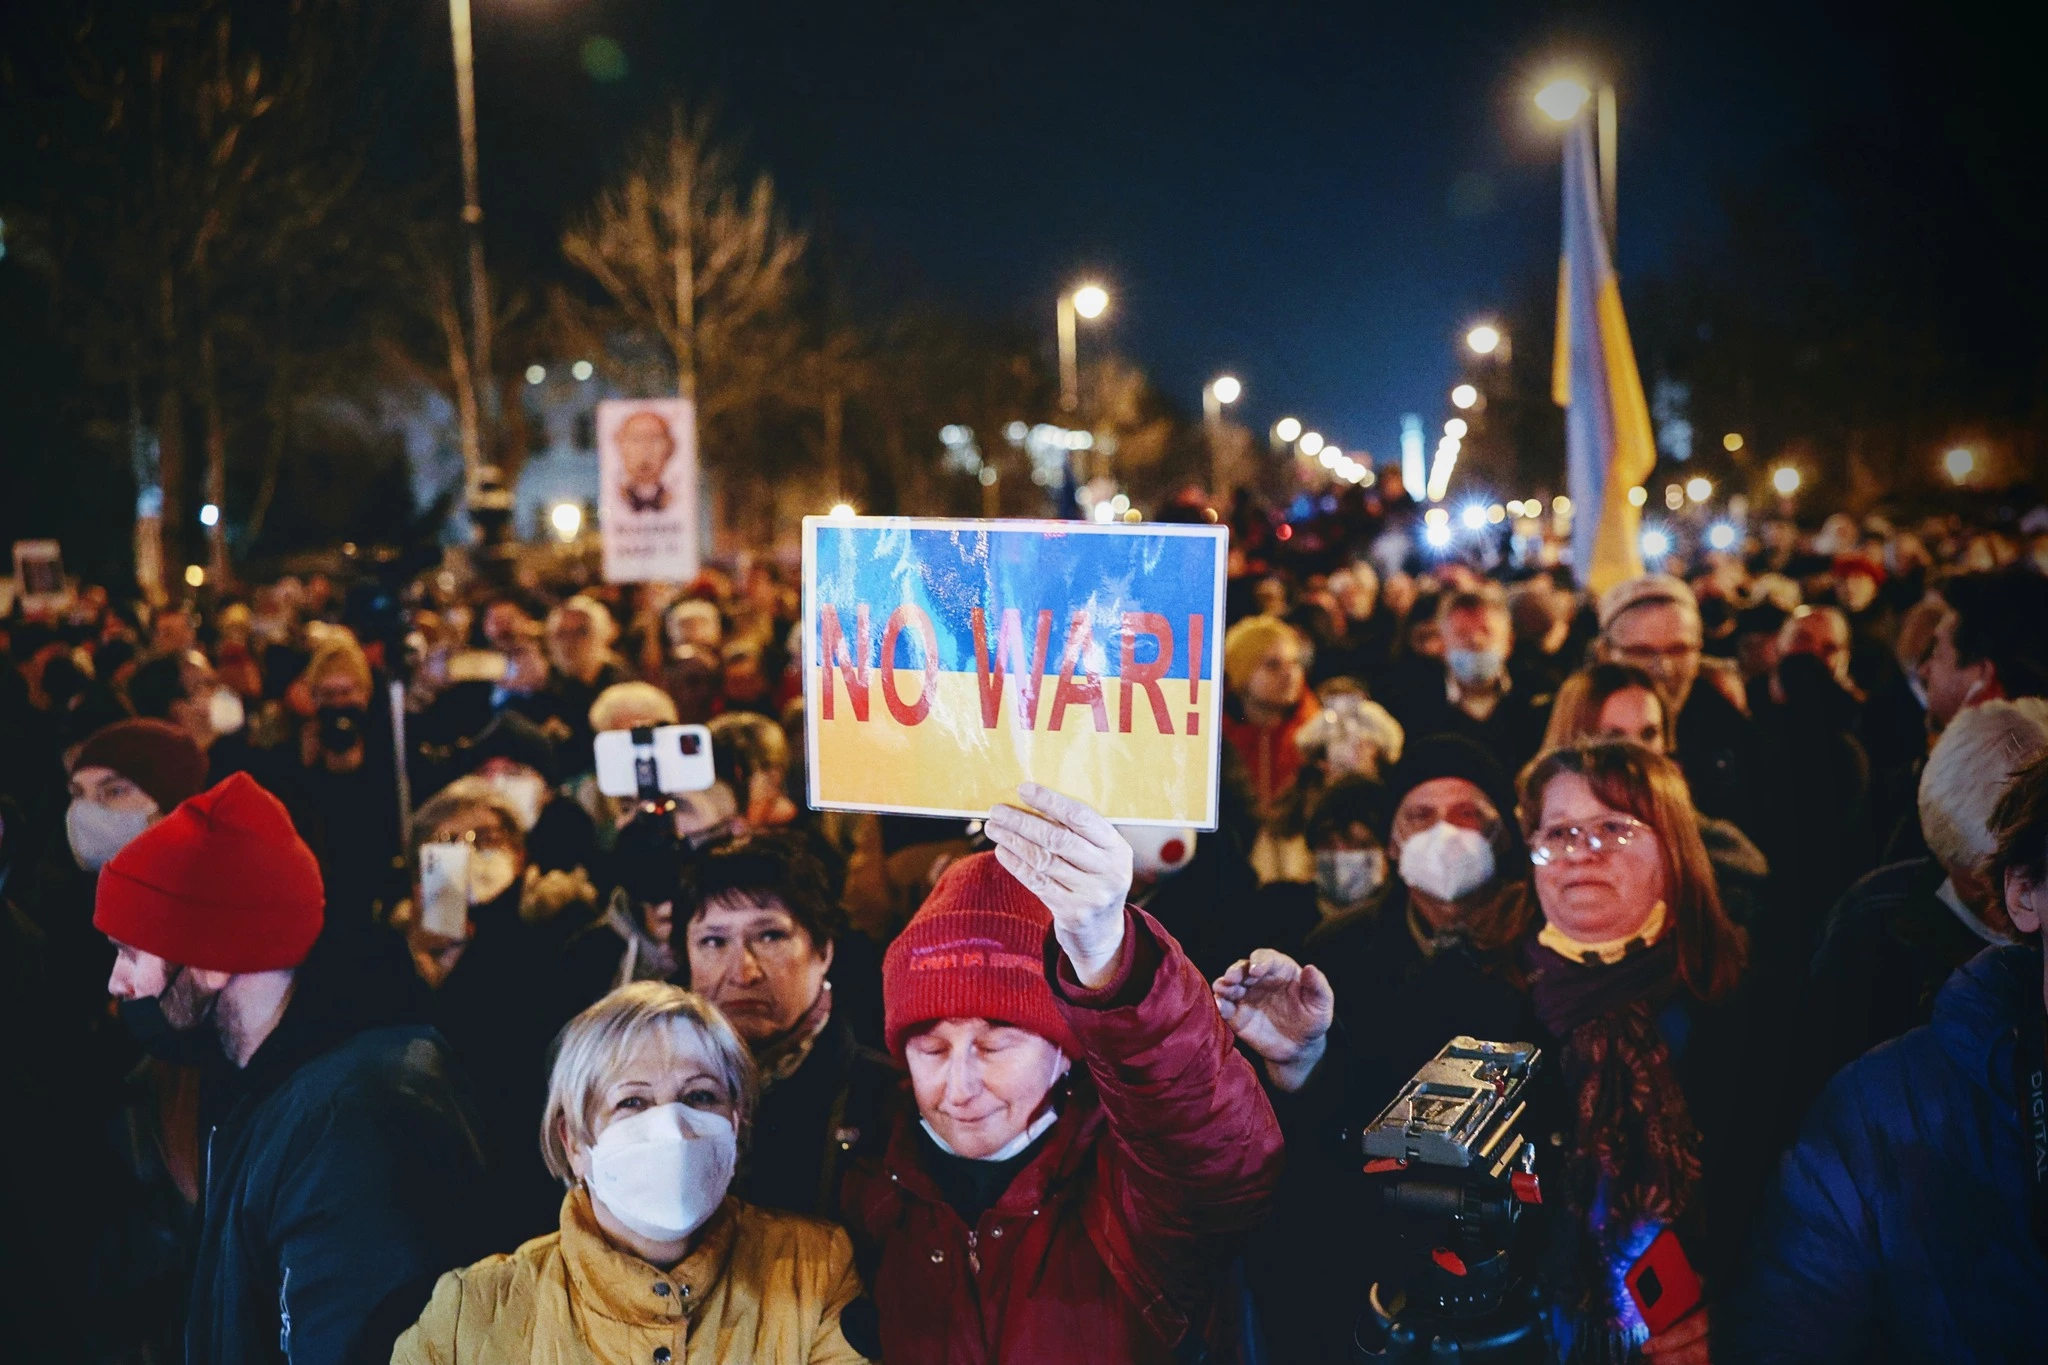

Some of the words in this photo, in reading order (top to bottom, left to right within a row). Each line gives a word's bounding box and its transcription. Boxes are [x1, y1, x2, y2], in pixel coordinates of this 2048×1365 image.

[821, 602, 938, 726] NO
[971, 607, 1204, 736] WAR!
[2031, 1070, 2047, 1183] DIGITAL
